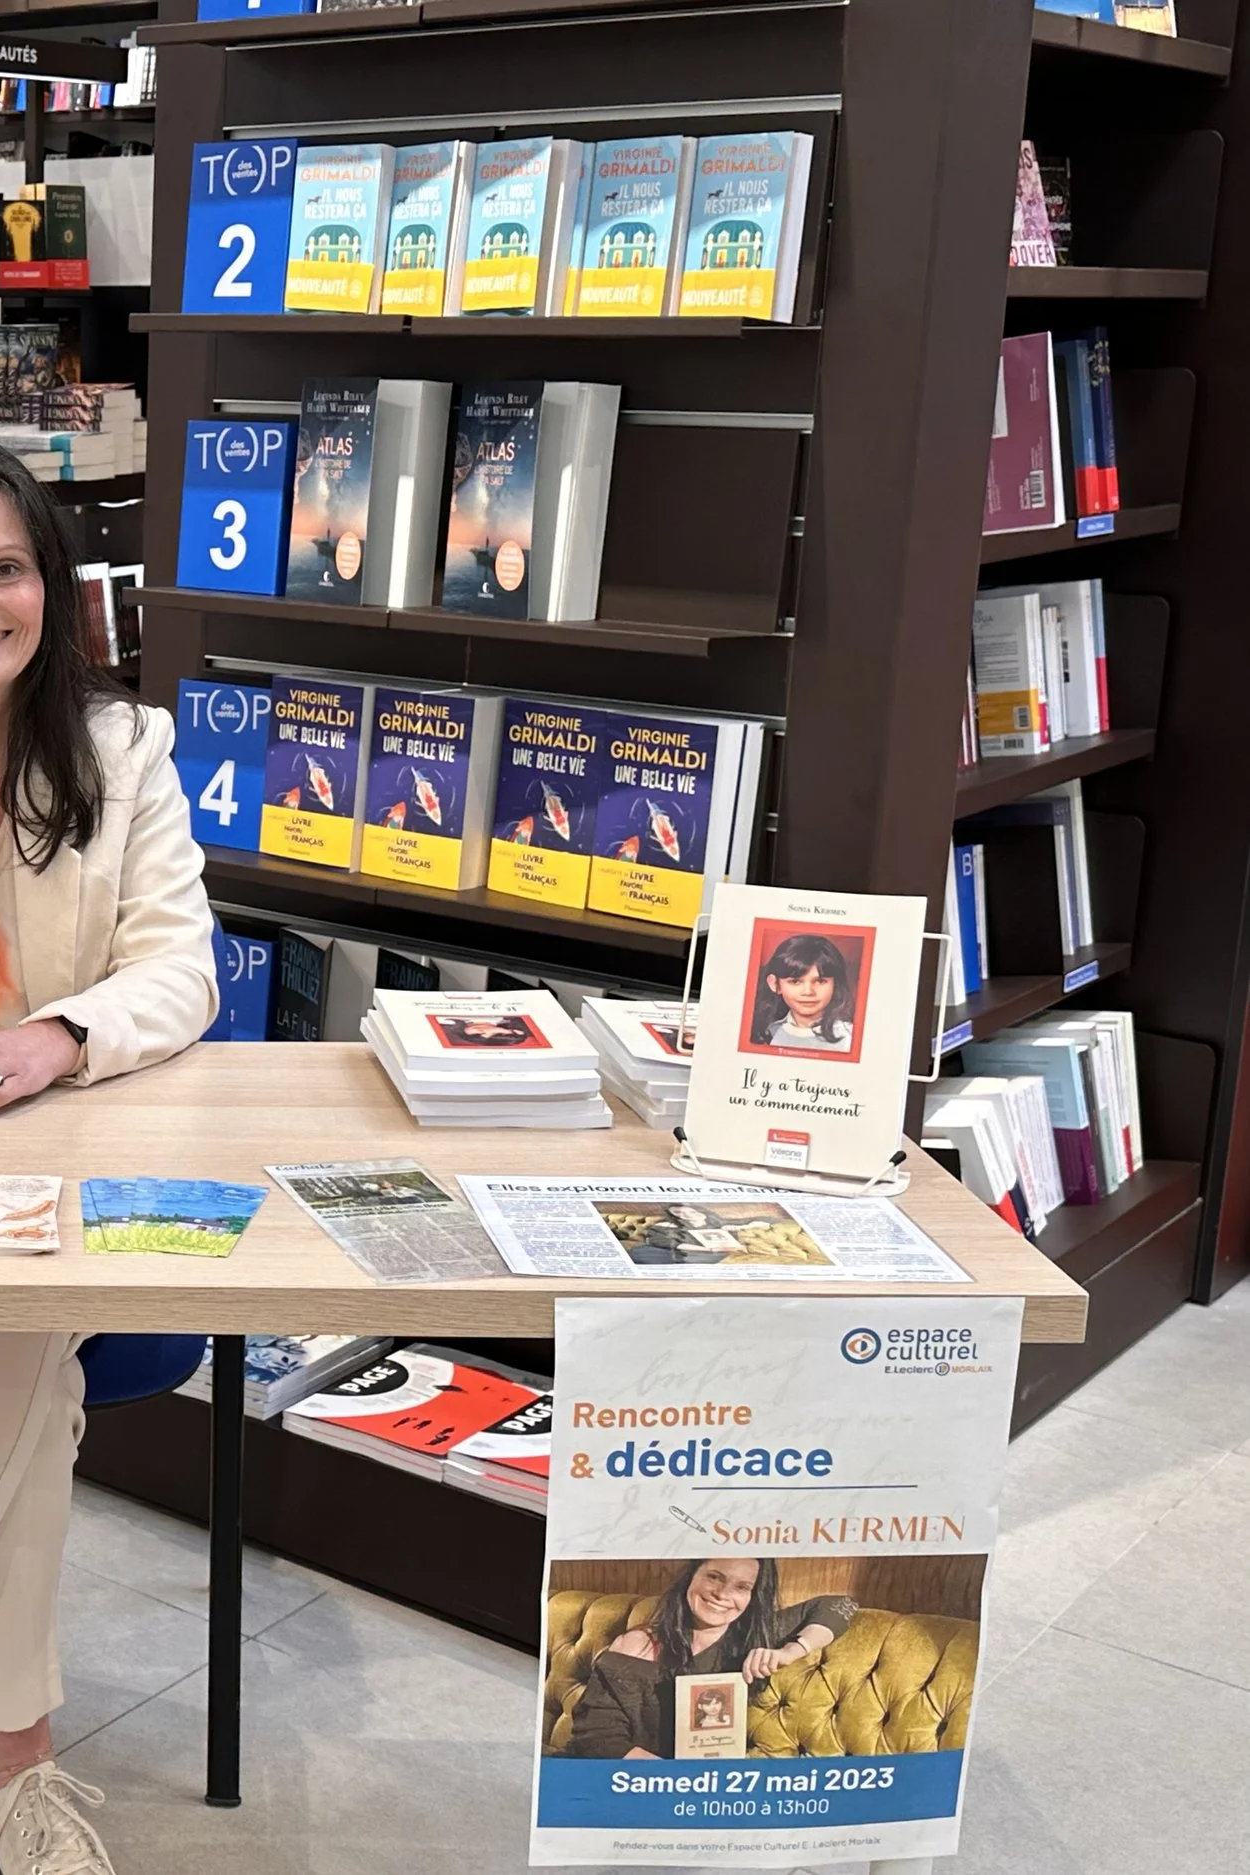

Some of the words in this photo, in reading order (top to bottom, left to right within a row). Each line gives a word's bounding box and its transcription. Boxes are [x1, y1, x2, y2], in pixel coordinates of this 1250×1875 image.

[613, 148, 663, 161] VIRGINIE
[718, 144, 772, 157] VIRGINIE
[300, 166, 376, 182] GRIMALDI
[480, 160, 547, 181] GRIMALDI
[598, 159, 676, 179] GRIMALDI
[701, 158, 786, 176] GRIMALDI
[213, 223, 256, 298] 2
[316, 437, 353, 455] ATLAS
[477, 442, 515, 461] ATLAS
[209, 499, 248, 571] 3
[289, 689, 341, 708] VIRGINIE
[275, 702, 355, 728] GRIMALDI
[394, 700, 450, 720] VIRGINIE
[379, 713, 465, 741] GRIMALDI
[525, 711, 583, 732] VIRGINIE
[279, 723, 297, 741] UNE
[301, 727, 328, 748] BELLE
[509, 725, 597, 754] GRIMALDI
[628, 727, 691, 748] VIRGINIE
[383, 735, 403, 754] UNE
[406, 740, 436, 761] BELLE
[610, 741, 707, 771] GRIMALDI
[512, 748, 533, 768] UNE
[536, 751, 567, 774] BELLE
[614, 764, 638, 786] UNE
[641, 769, 674, 792] BELLE
[199, 759, 239, 826] 4
[291, 817, 312, 828] LIVRE
[291, 834, 325, 848] FRANÇAIS
[396, 838, 418, 849] LIVRE
[395, 855, 432, 870] FRANÇAIS
[522, 853, 545, 865] LIVRE
[521, 872, 558, 887] FRANÇAIS
[630, 871, 655, 884] LIVRE
[628, 890, 670, 906] FRANÇAIS
[276, 1008, 289, 1026] LA
[742, 1067, 756, 1090] Il
[762, 1079, 773, 1098] y
[779, 1081, 790, 1092] a
[790, 1077, 851, 1103] toujours
[729, 1095, 749, 1107] un
[754, 1097, 866, 1118] commencement
[485, 1183, 543, 1193] Elles
[547, 1183, 657, 1195] explorent
[659, 1184, 709, 1194] leur
[887, 1327, 973, 1346] espace
[885, 1343, 979, 1361] culturel
[338, 1362, 397, 1394] PAGE
[951, 1365, 993, 1374] MORLAIX
[572, 1400, 752, 1430] Rencontre
[570, 1452, 595, 1480] &
[605, 1437, 834, 1479] dédicace
[712, 1518, 800, 1545] Sonia
[811, 1515, 966, 1544] KERMEN
[610, 1769, 719, 1795] Samedi
[725, 1771, 759, 1794] 27
[765, 1768, 817, 1793] mai
[823, 1766, 895, 1791] 2023
[673, 1801, 697, 1817] de
[702, 1800, 756, 1818] 10h00
[760, 1798, 771, 1816] à
[775, 1798, 829, 1815] 13h00
[613, 1840, 675, 1851] Rendez-vous
[700, 1842, 726, 1852] votre
[727, 1842, 762, 1852] Espace
[763, 1840, 800, 1851] Culturel
